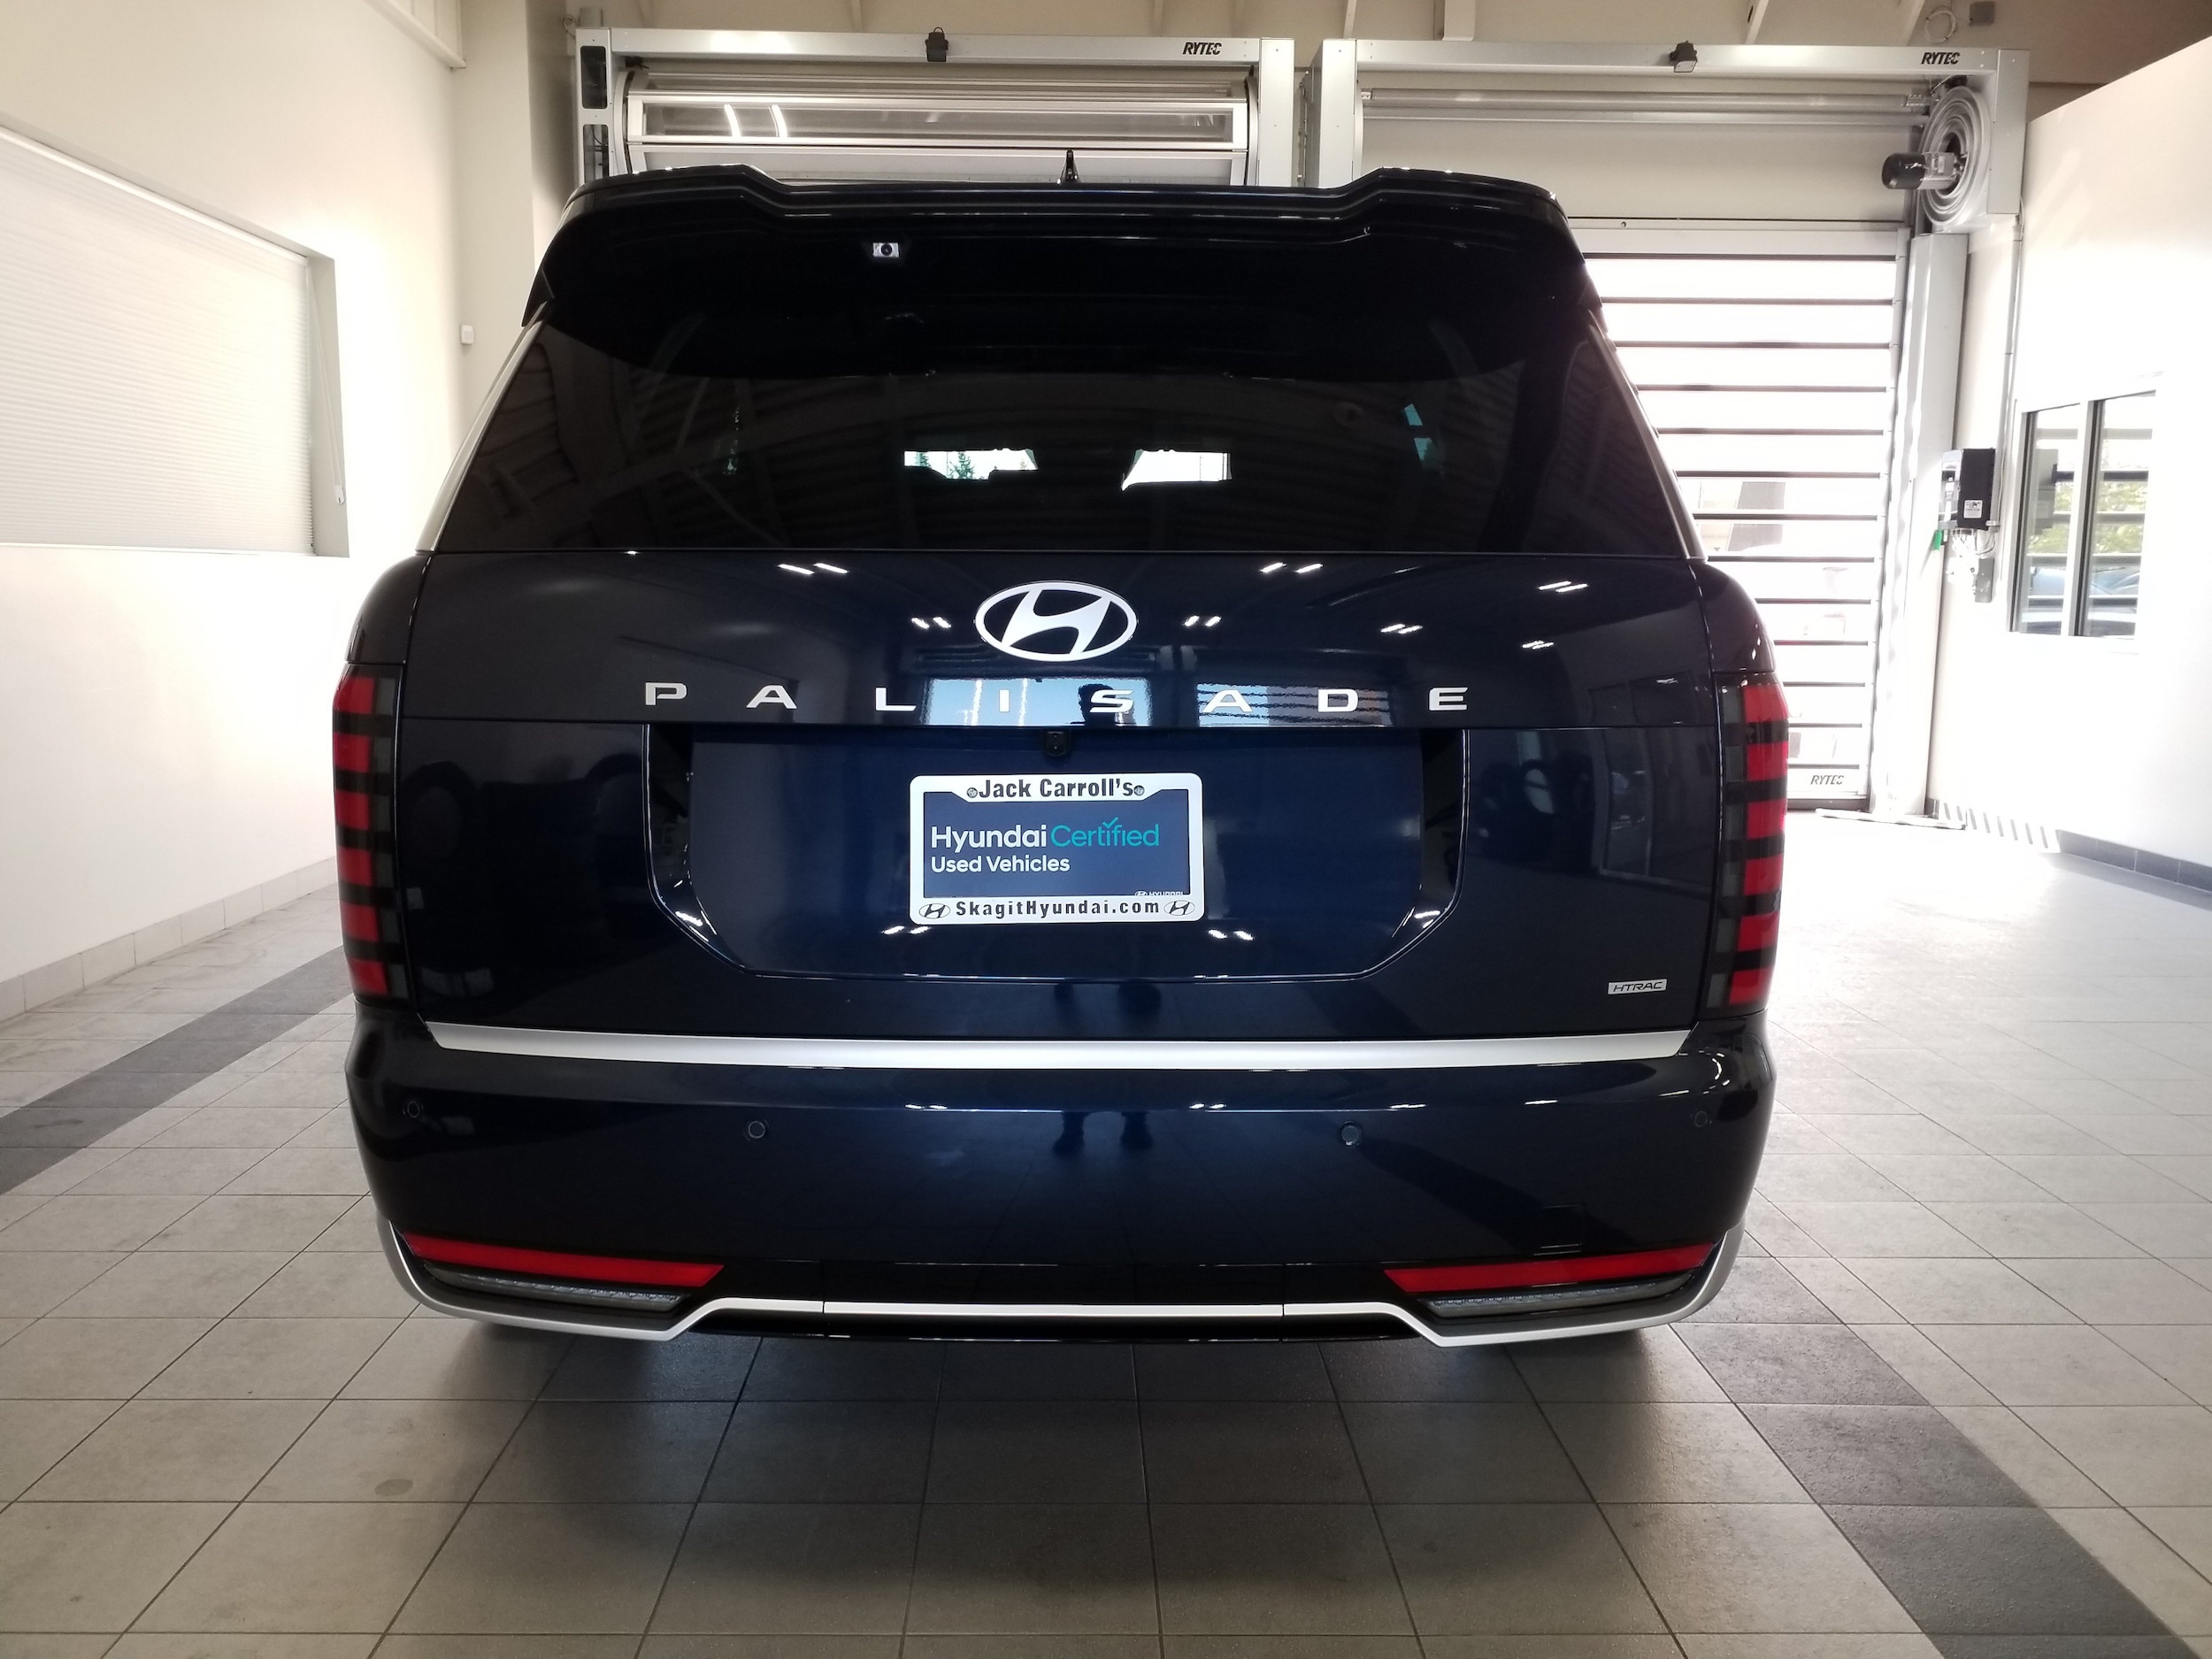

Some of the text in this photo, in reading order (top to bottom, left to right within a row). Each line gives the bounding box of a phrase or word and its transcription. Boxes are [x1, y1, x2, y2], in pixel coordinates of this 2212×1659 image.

[1182, 42, 1223, 55] RYTEC
[1920, 51, 1961, 65] RYTEC
[644, 681, 1469, 714] PALISADE
[979, 778, 1134, 798] Jack Carroll's
[1810, 774, 1845, 785] RYTEC
[931, 818, 1160, 854] Hyundai Certified
[931, 855, 1071, 873] Used Vehicles
[956, 899, 1160, 919] SkagitHyundai.com
[1613, 981, 1663, 992] HTRAC
